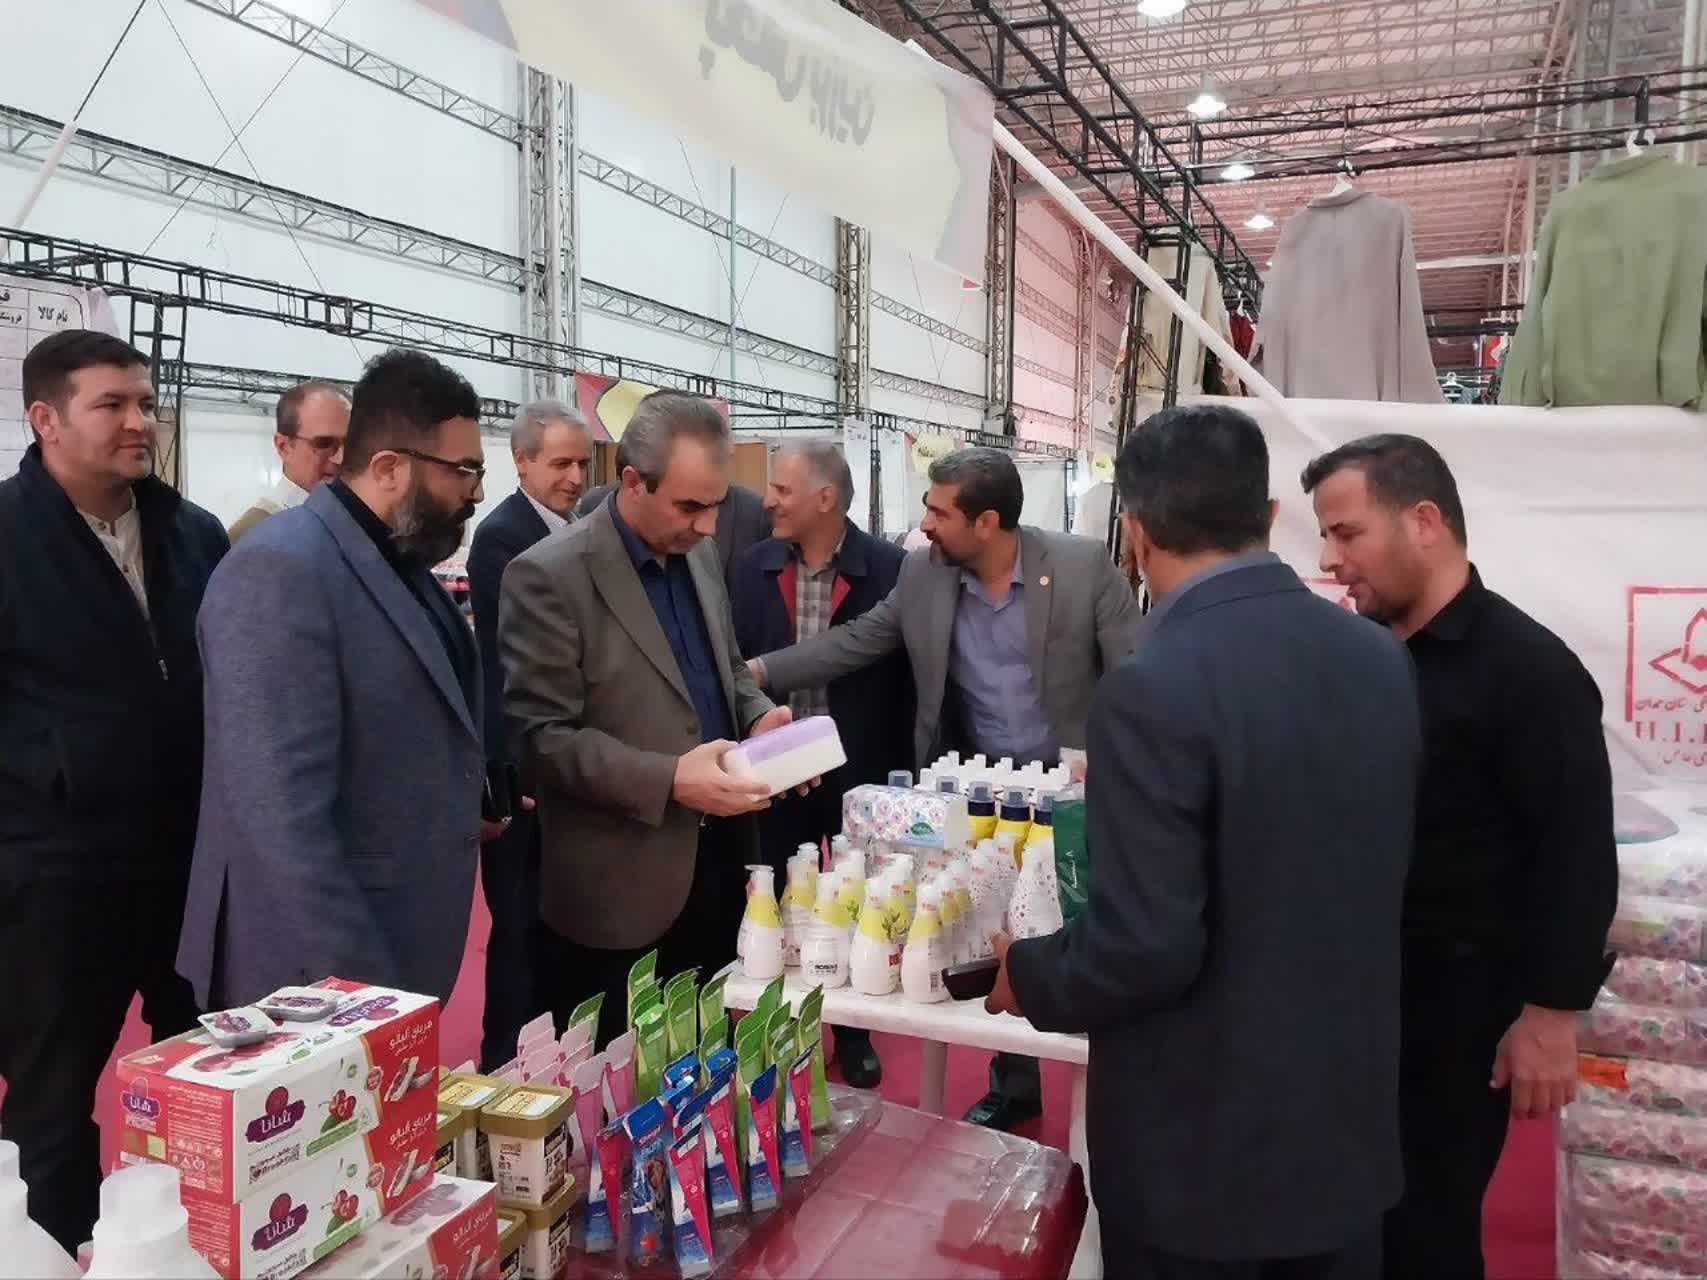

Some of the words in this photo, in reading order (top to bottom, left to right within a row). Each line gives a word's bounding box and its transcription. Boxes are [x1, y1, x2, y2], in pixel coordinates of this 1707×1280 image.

[38, 305, 55, 321] کالا
[55, 308, 68, 325] نام
[261, 1109, 292, 1133] شانا
[264, 1214, 297, 1241] شانا
